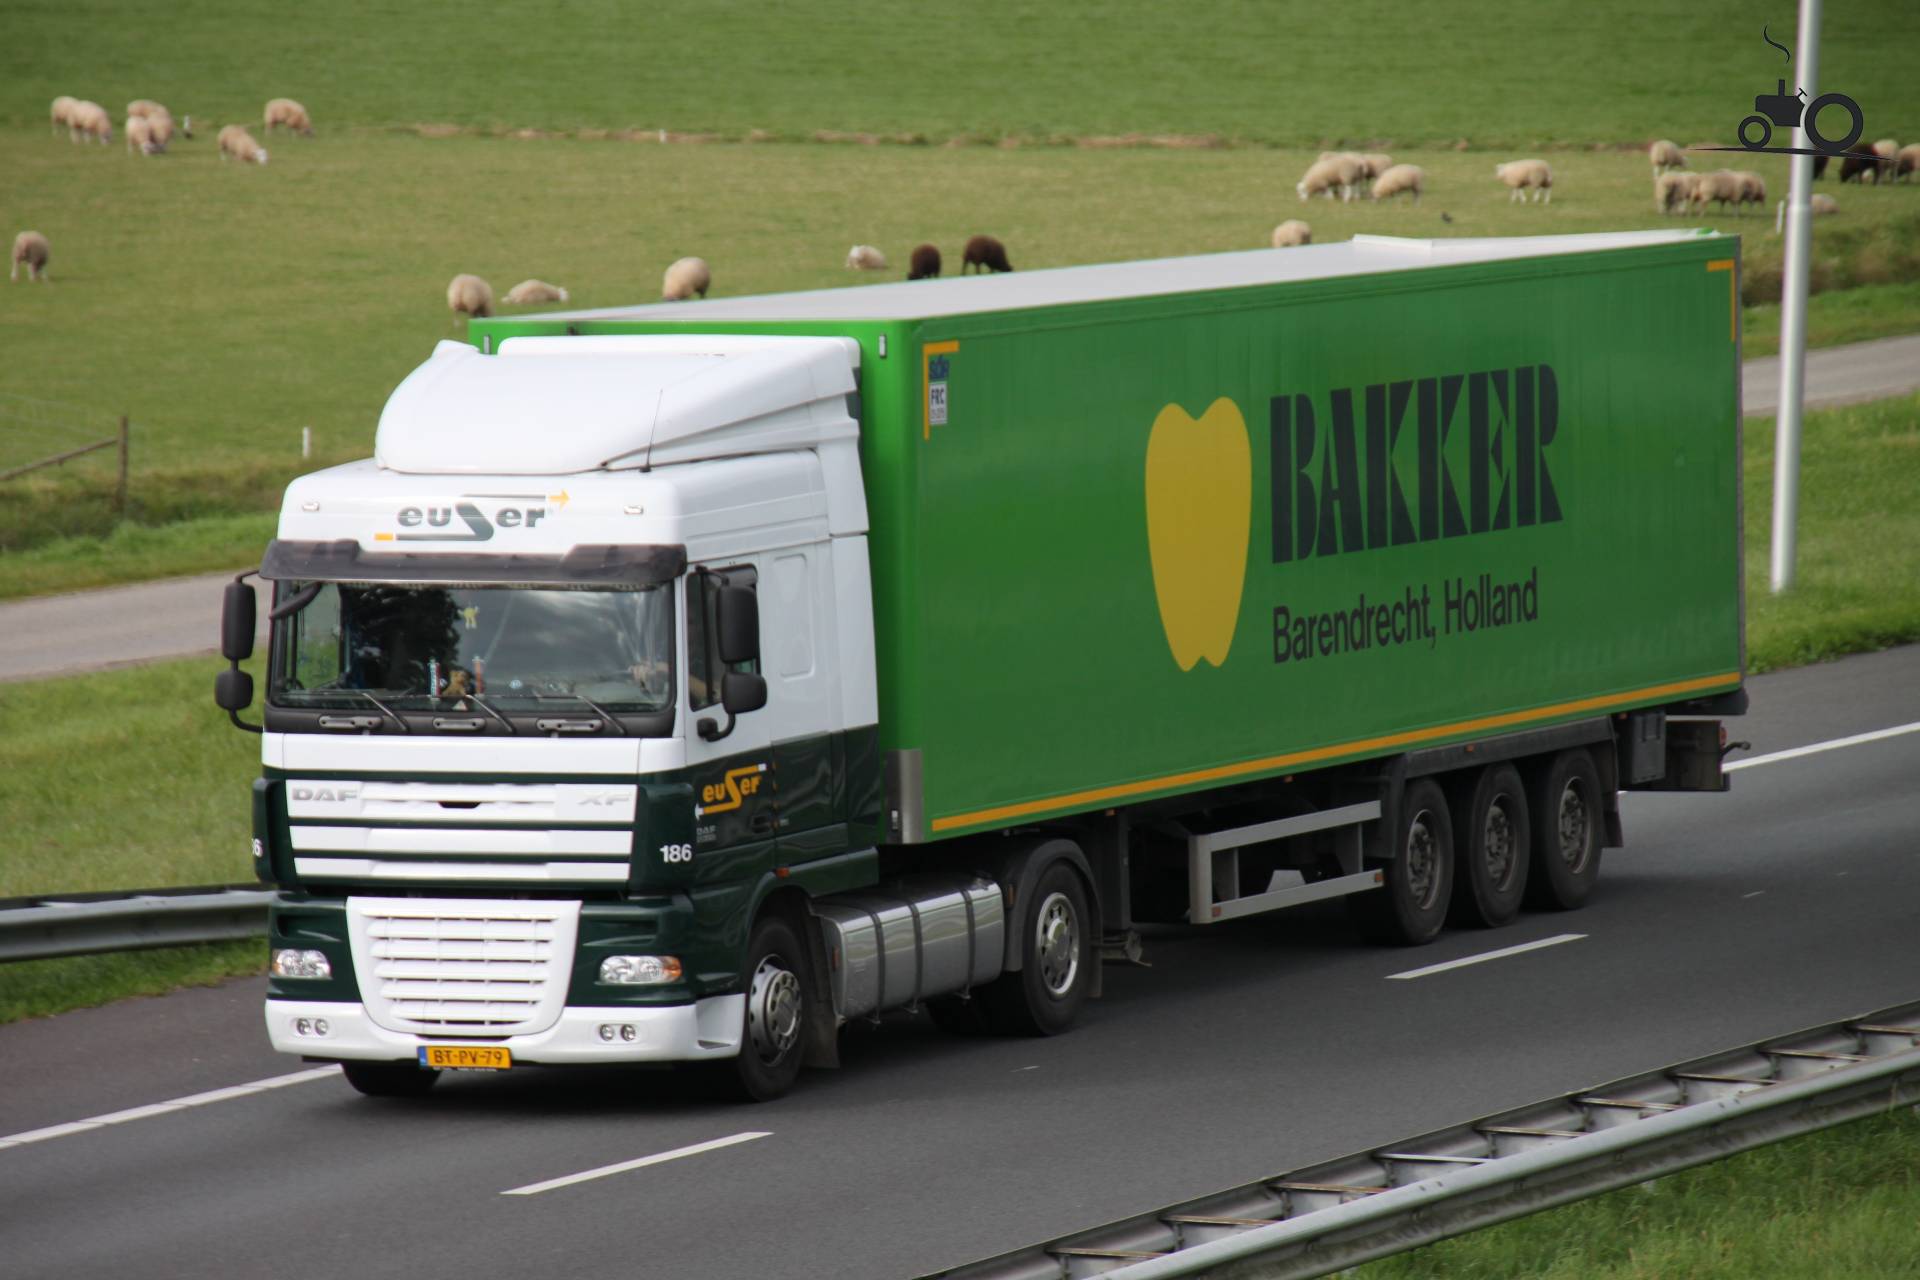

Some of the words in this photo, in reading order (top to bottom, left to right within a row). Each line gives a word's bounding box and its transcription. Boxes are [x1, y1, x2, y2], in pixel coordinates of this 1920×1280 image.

[1270, 364, 1564, 564] BAKKER
[1273, 585, 1436, 664] Barendrecht,
[1444, 566, 1538, 635] Holland
[292, 788, 357, 802] DAF
[660, 843, 692, 863] 186
[433, 1049, 503, 1064] BT-PV-79
